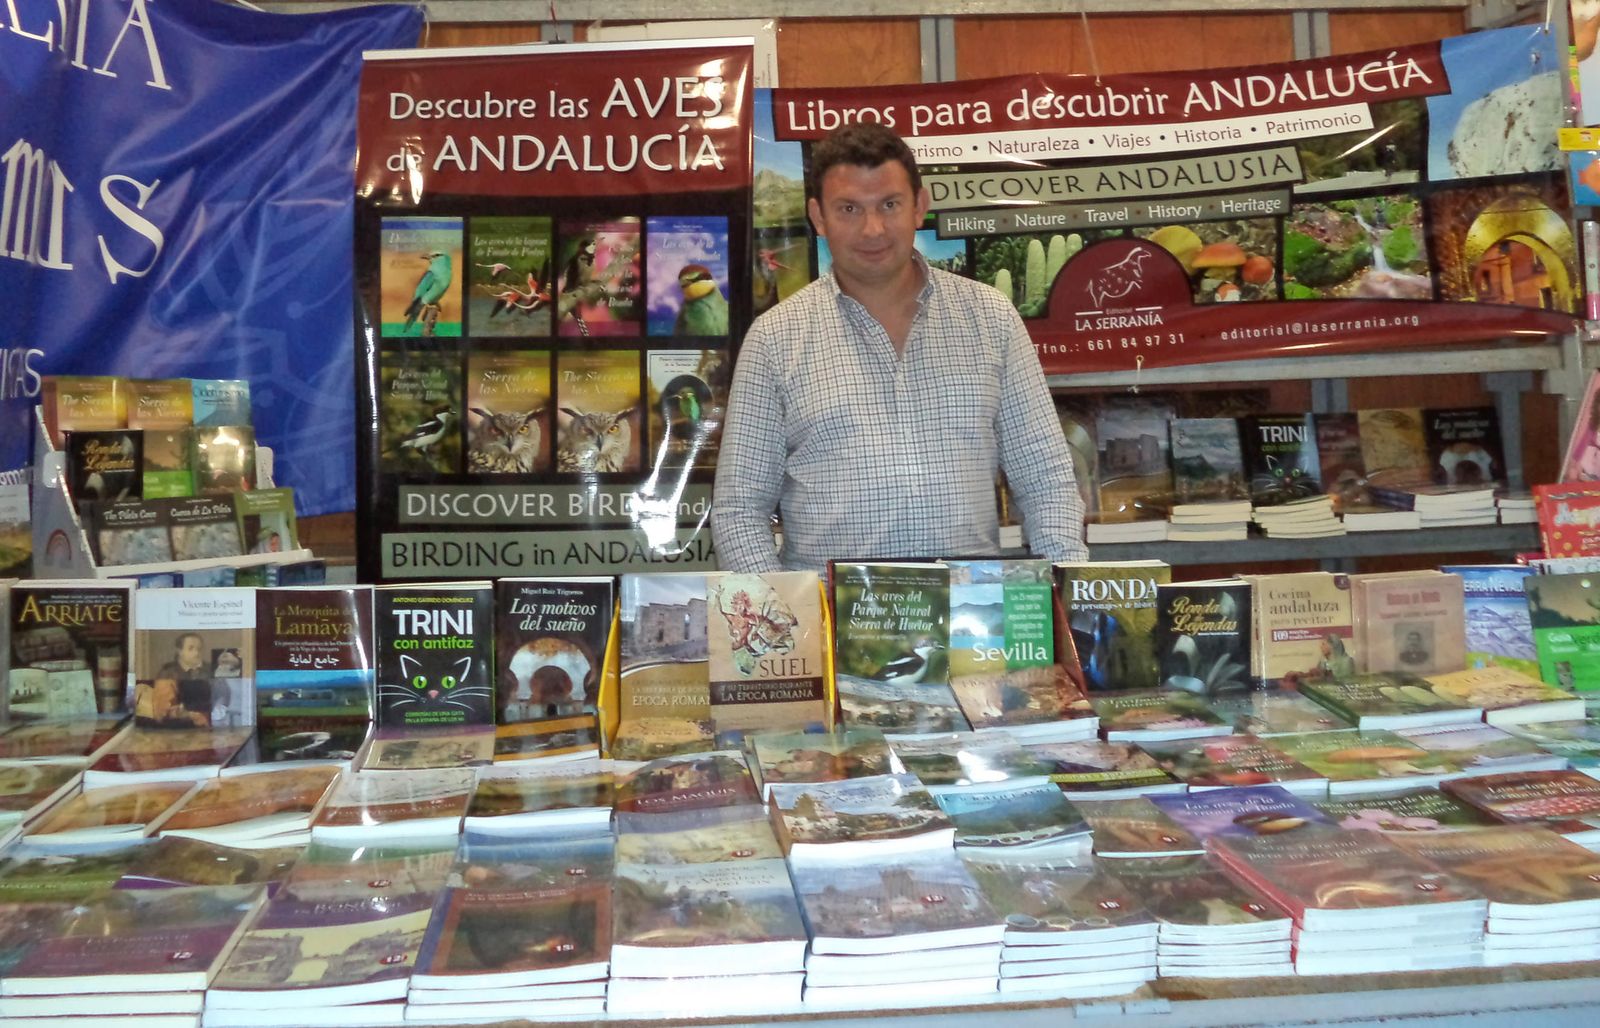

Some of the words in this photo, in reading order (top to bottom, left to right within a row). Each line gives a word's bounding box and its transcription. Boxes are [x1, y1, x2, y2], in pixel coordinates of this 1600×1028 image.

[389, 91, 536, 120] Descubre
[549, 90, 589, 119] las
[601, 76, 724, 119] AVES
[787, 99, 896, 131] Libros
[910, 100, 993, 136] para
[1006, 82, 1169, 122] descubrir
[1183, 50, 1434, 115] ANDALUCÍA
[386, 147, 423, 173] de
[432, 123, 726, 173] ANDALUCÍA
[910, 144, 964, 159] erismo
[988, 136, 1080, 157] Naturaleza
[1102, 133, 1151, 151] Viajes
[1174, 126, 1242, 145] Historia
[1266, 111, 1363, 136] Patrimonio
[929, 175, 1085, 202] DISCOVER
[1096, 153, 1294, 193] ANDALUSIA
[947, 216, 996, 233] Hiking
[1015, 212, 1066, 227] Nature
[1084, 207, 1129, 222] Travel
[1148, 203, 1202, 221] History
[1221, 197, 1282, 217] Heritage
[1075, 318, 1093, 332] LA
[1096, 311, 1164, 330] SERRANÍA
[1220, 314, 1420, 342] editorial@laserrania.org
[1087, 338, 1113, 352] 661
[1121, 336, 1138, 349] 84
[1145, 334, 1162, 347] 97
[1169, 332, 1185, 346] 31
[1258, 425, 1309, 443] TRINI
[406, 493, 557, 518] DISCOVER
[568, 492, 645, 516] BIRD
[392, 541, 524, 567] BIRDING
[533, 543, 556, 565] in
[1070, 577, 1158, 601] RONDA
[509, 597, 539, 615] Los
[540, 599, 598, 616] motivos
[392, 609, 474, 636] TRINI
[519, 614, 543, 631] del
[544, 617, 586, 632] sueño
[393, 639, 419, 650] con
[422, 636, 474, 650] antifaz
[972, 642, 1048, 662] Sevilla
[759, 657, 813, 677] SUEL
